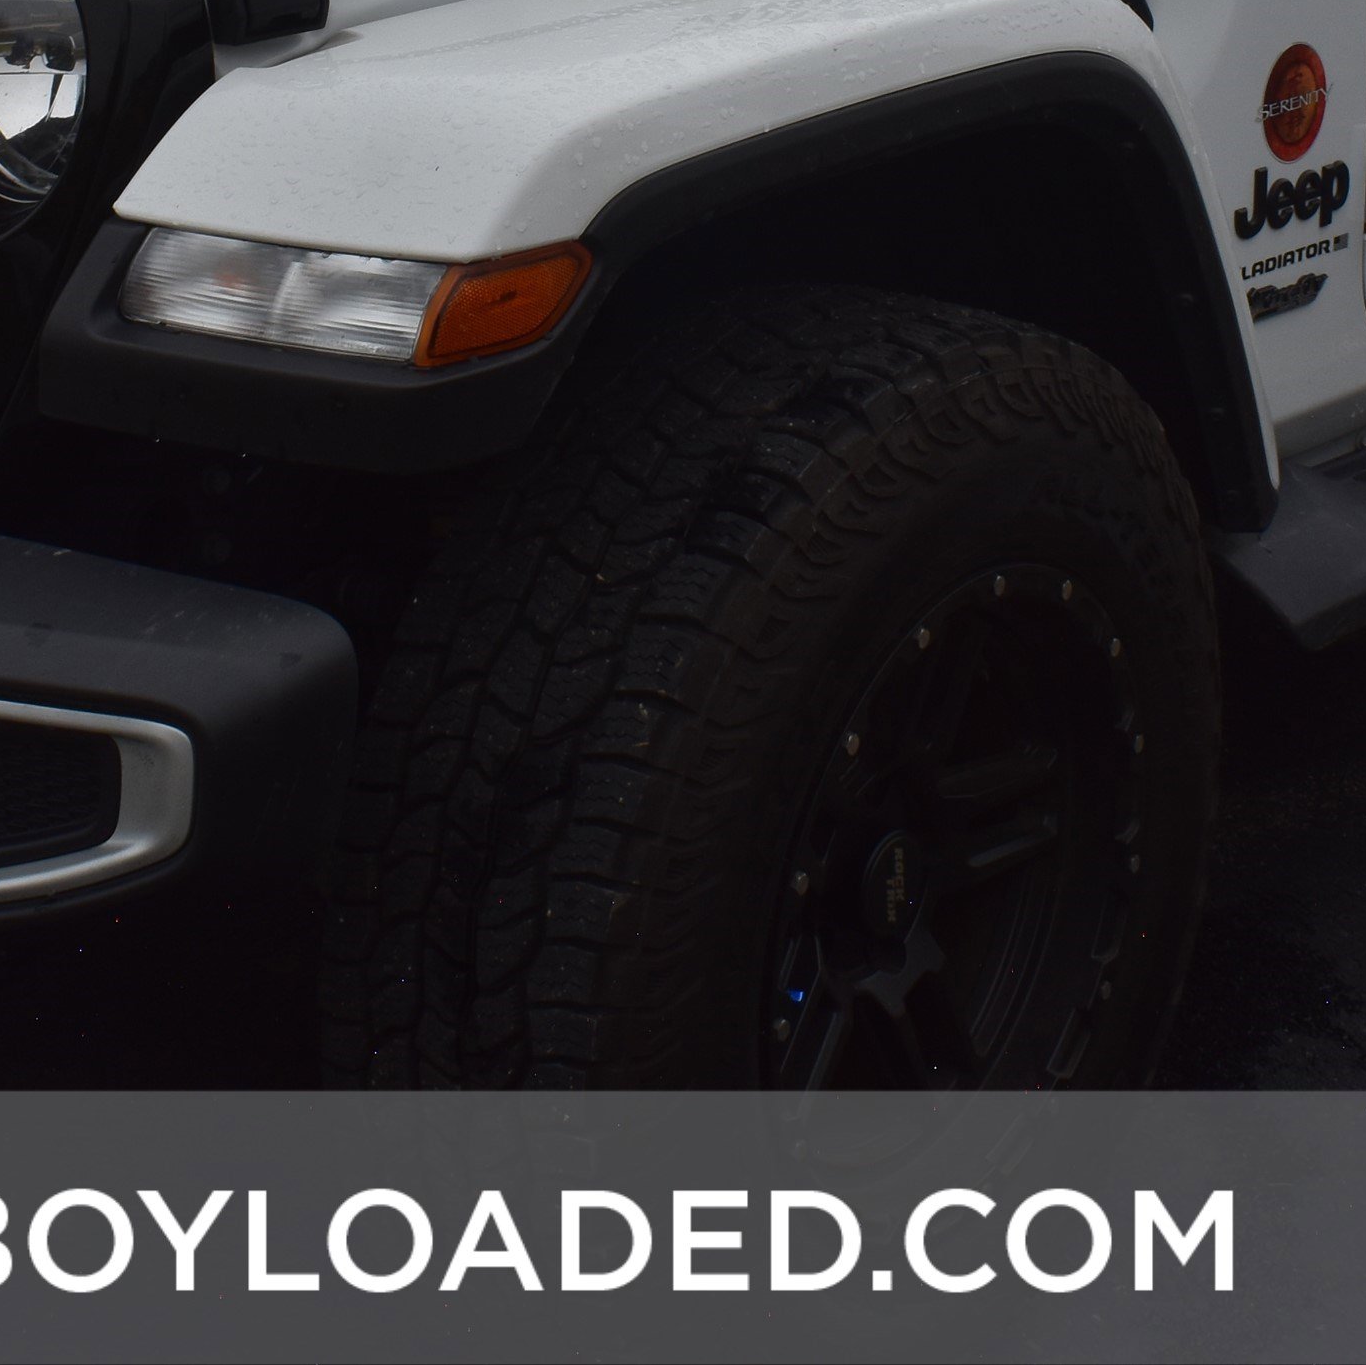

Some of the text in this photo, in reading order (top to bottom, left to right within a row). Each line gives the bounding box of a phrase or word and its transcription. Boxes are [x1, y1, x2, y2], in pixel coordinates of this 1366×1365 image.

[1256, 82, 1334, 123] SERENITY
[1234, 160, 1350, 240] Jeep
[1241, 239, 1332, 281] LADIATOR
